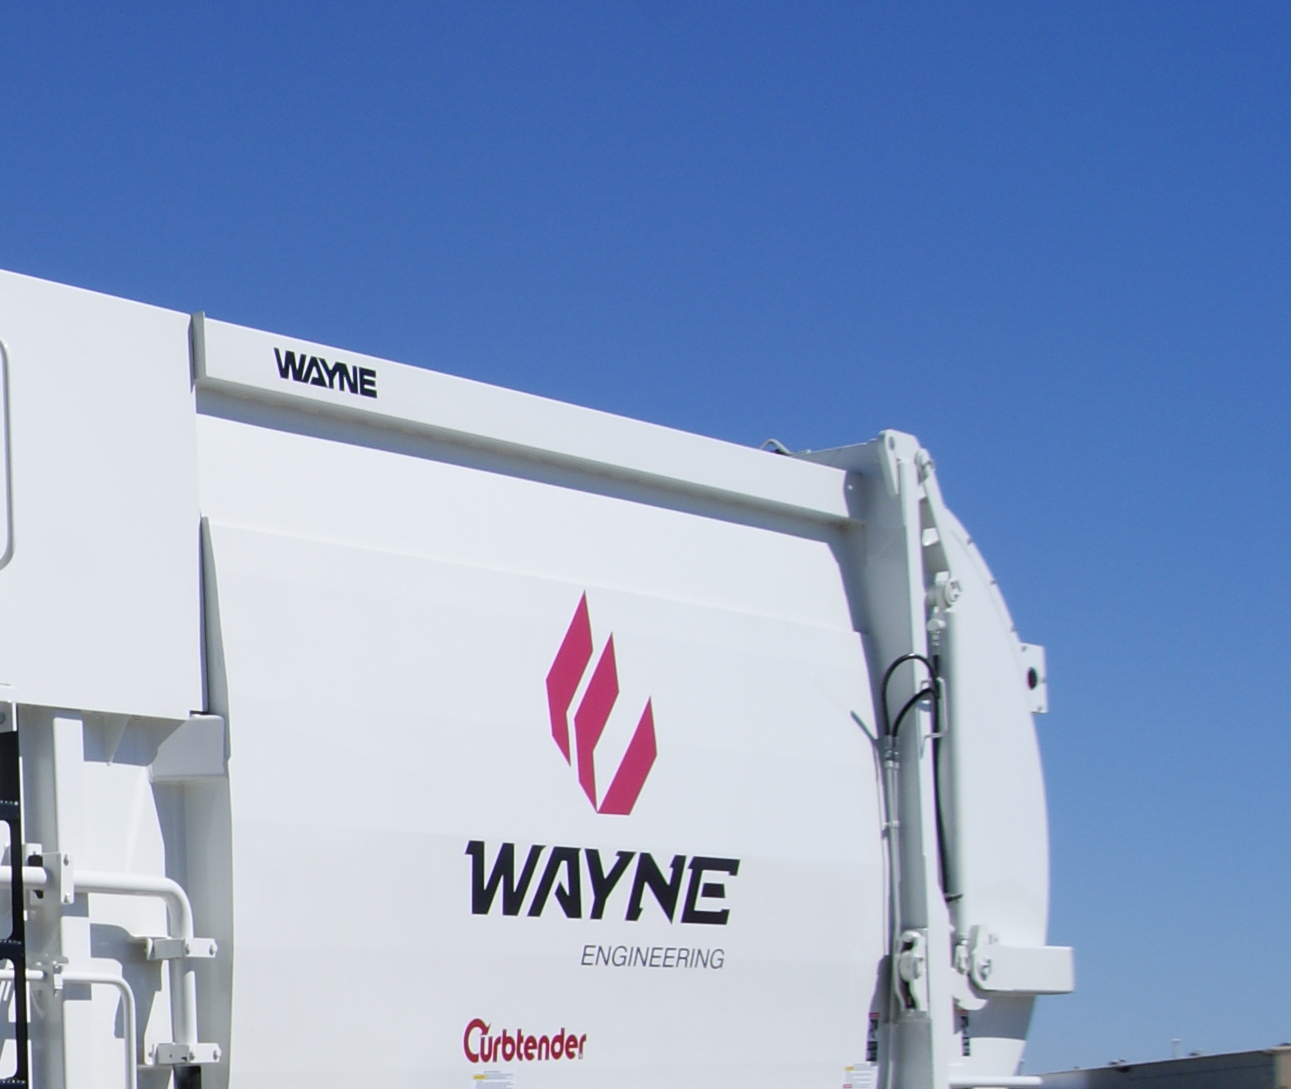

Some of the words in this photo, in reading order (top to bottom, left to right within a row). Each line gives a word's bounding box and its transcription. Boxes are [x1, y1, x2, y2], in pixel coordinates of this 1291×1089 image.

[273, 347, 378, 399] WAYNE
[464, 840, 741, 925] WAYNE
[580, 944, 725, 969] ENGINEERING
[463, 1018, 587, 1063] Curbtender
